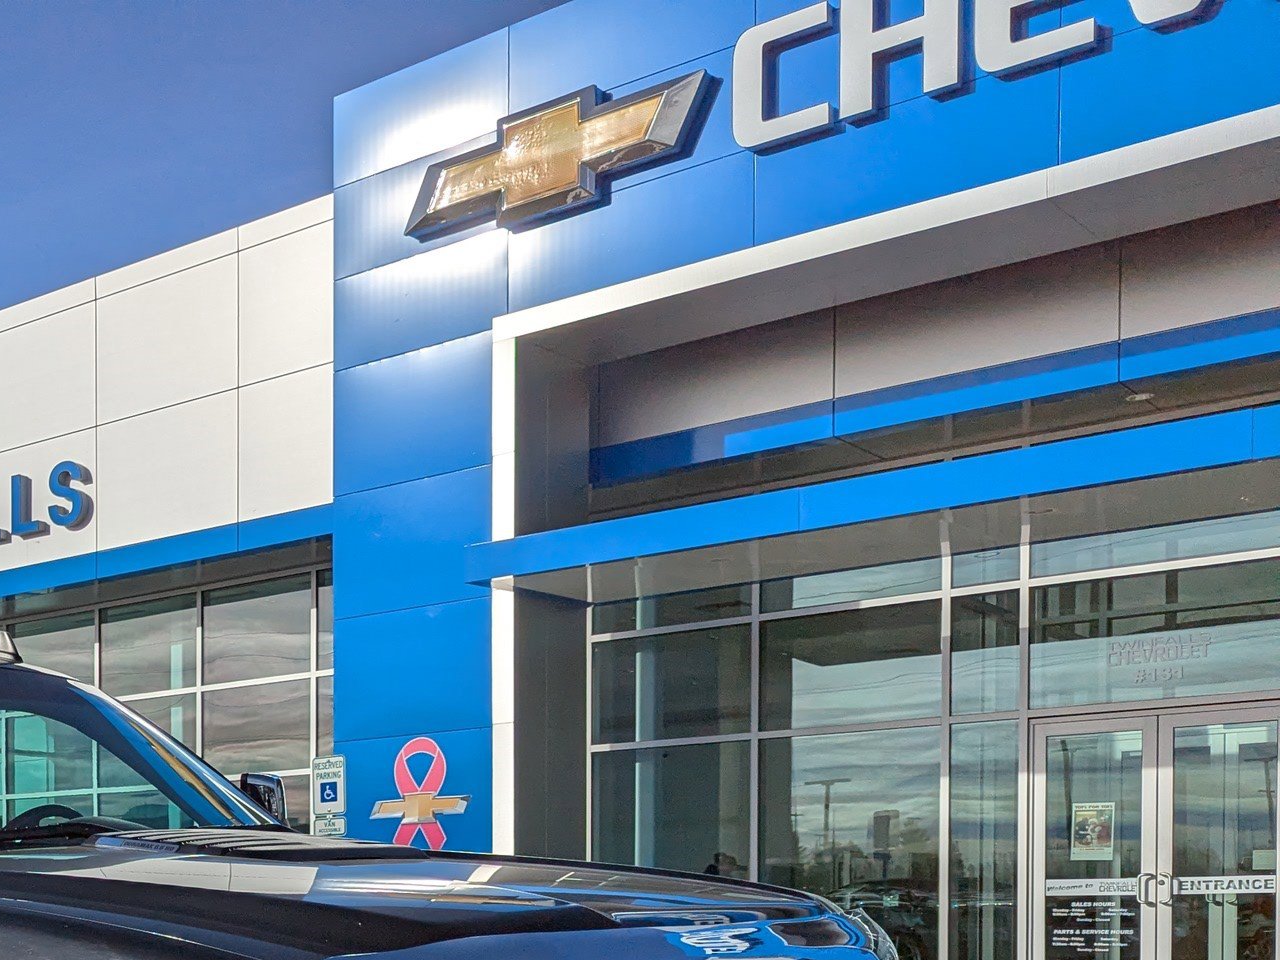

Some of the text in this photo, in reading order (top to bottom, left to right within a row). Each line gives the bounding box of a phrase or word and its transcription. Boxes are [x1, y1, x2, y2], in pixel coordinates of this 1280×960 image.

[732, 0, 1222, 153] CHE
[1106, 641, 1212, 667] CHEVROLET
[314, 760, 343, 770] RESERVED
[315, 771, 342, 780] PARKING
[1047, 884, 1083, 892] Welcome
[1180, 879, 1274, 890] ENTRANCE
